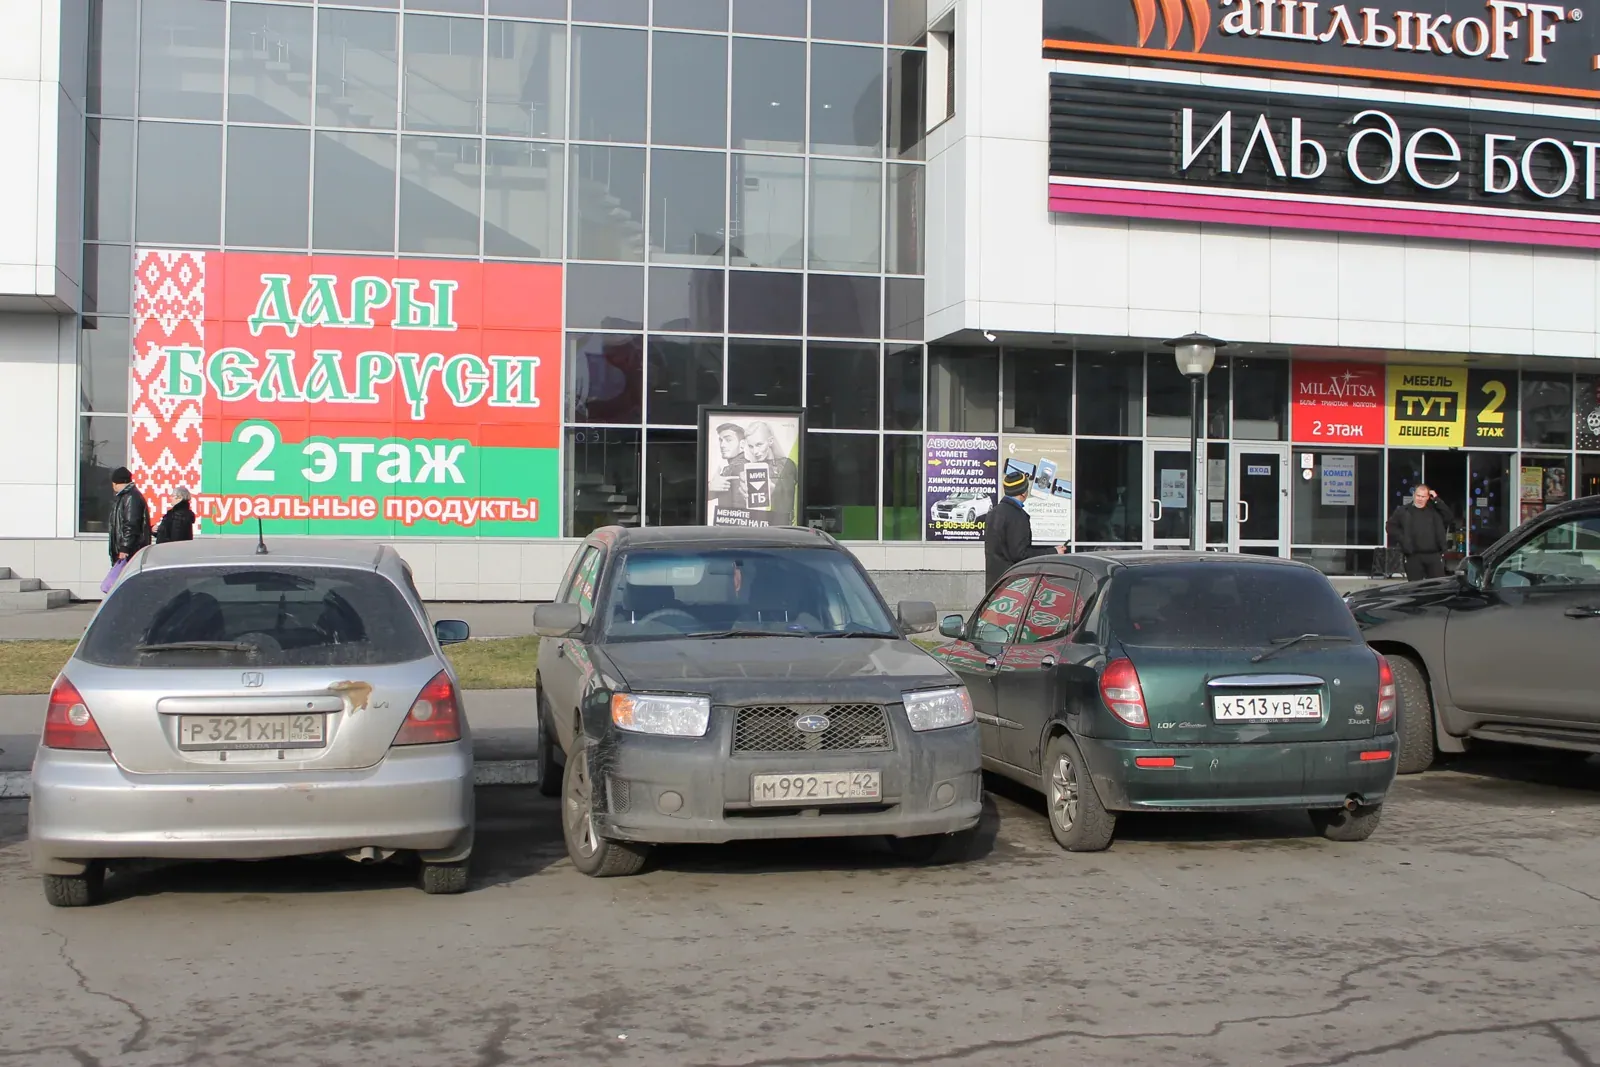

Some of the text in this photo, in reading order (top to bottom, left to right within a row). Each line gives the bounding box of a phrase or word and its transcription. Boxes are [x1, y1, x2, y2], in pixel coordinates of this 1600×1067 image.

[1181, 107, 1328, 180] ИЛЬ
[250, 273, 458, 337] ДАРЫ
[161, 346, 540, 421] БЕЛАРУСИ
[1403, 375, 1453, 387] МЕБЕЛЬ
[1402, 395, 1452, 417] ТУТ
[1476, 380, 1507, 424] 2
[1312, 420, 1363, 437] 2 этаж
[1398, 425, 1450, 437] ДЕШЕВЛЕ
[1476, 427, 1505, 438] ЭТАЖ
[927, 437, 998, 450] АВТОМОЙКА
[236, 425, 465, 484] 2 этаж
[935, 450, 968, 458] КОМЕТЕ
[945, 459, 980, 467] УСЛУГИ:
[749, 471, 766, 480] МИН
[940, 467, 965, 475] МОЙКА
[1323, 469, 1353, 477] КОМЕТА
[928, 477, 968, 485] ХИМЧИСТКА
[928, 485, 996, 494] ПОЛИРОВКА КУЗОВА
[751, 492, 766, 504] ГБ
[386, 498, 536, 525] продукты
[716, 509, 750, 518] МЕНЯЙТЕ
[716, 517, 747, 526] МИНУТЫ
[748, 519, 759, 527] НА
[1297, 696, 1314, 710] 42
[292, 715, 315, 733] 42
[853, 773, 873, 789] 42
